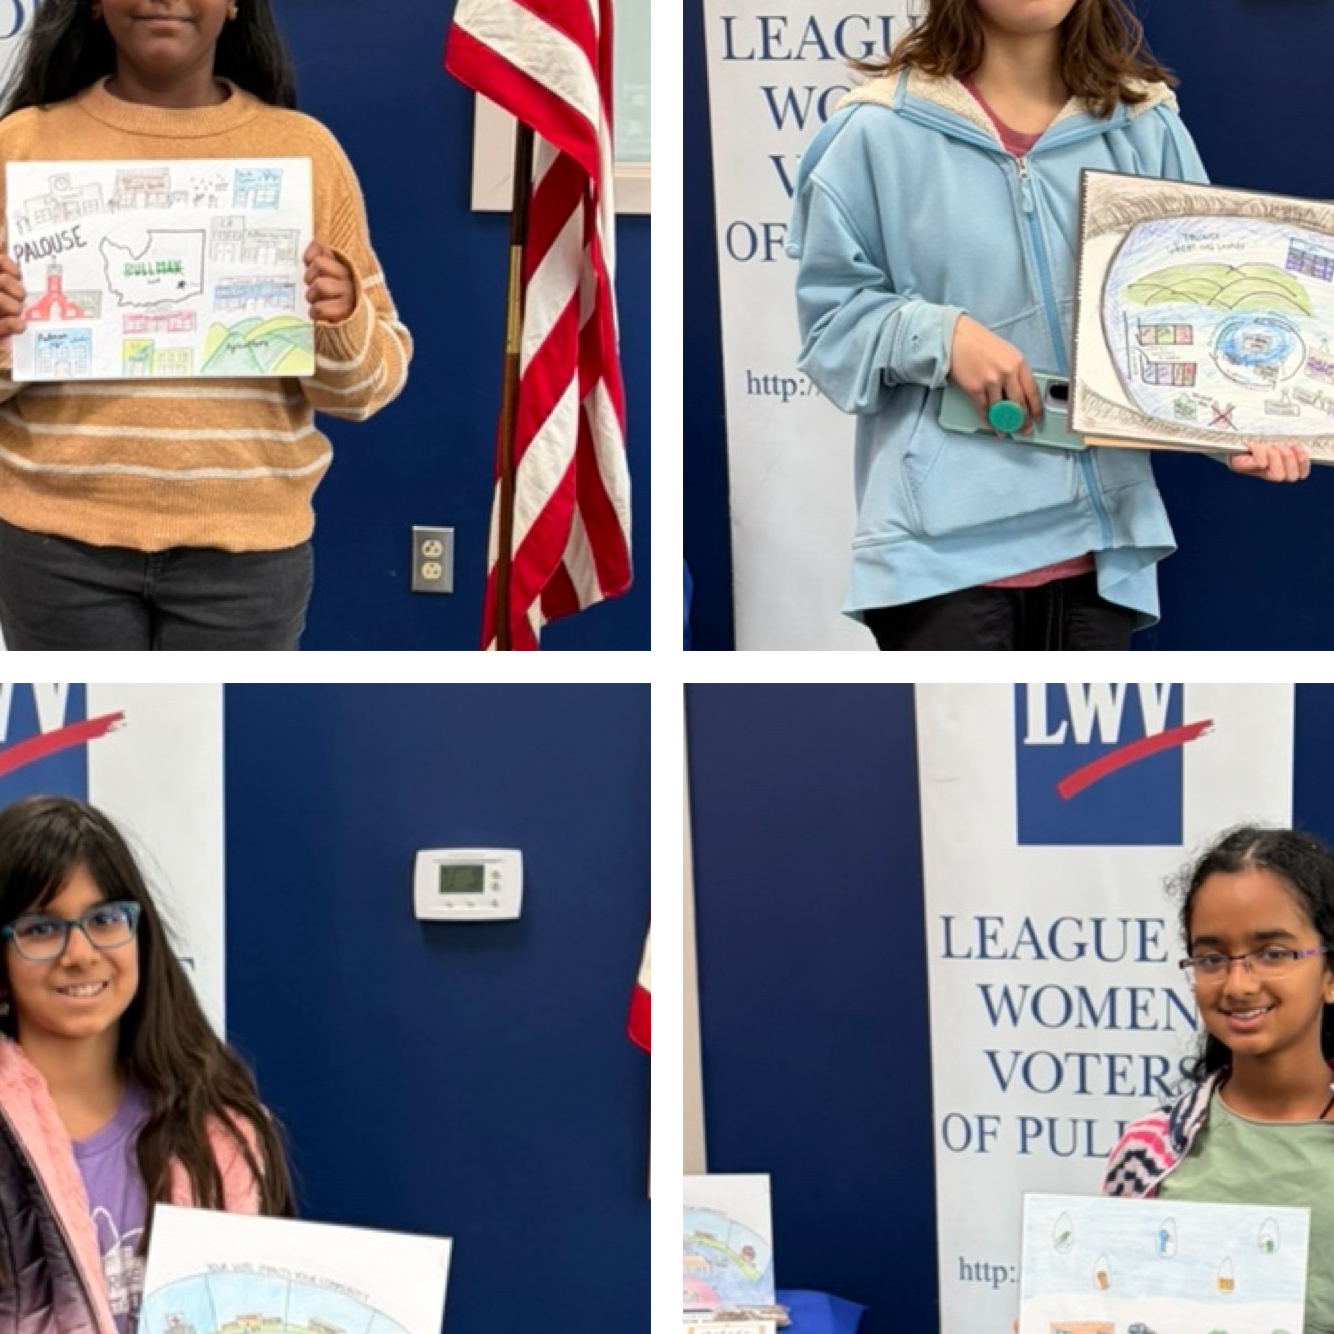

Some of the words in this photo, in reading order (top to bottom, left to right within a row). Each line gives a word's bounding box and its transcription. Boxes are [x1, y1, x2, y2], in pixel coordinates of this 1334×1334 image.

[720, 14, 918, 61] LEAGU
[13, 225, 87, 265] PALOUSE
[727, 221, 785, 261] OF
[1023, 684, 1174, 746] LWV
[943, 916, 1167, 962] LEAGUE
[976, 983, 1195, 1031] WOMEN
[943, 1113, 1000, 1153] OF
